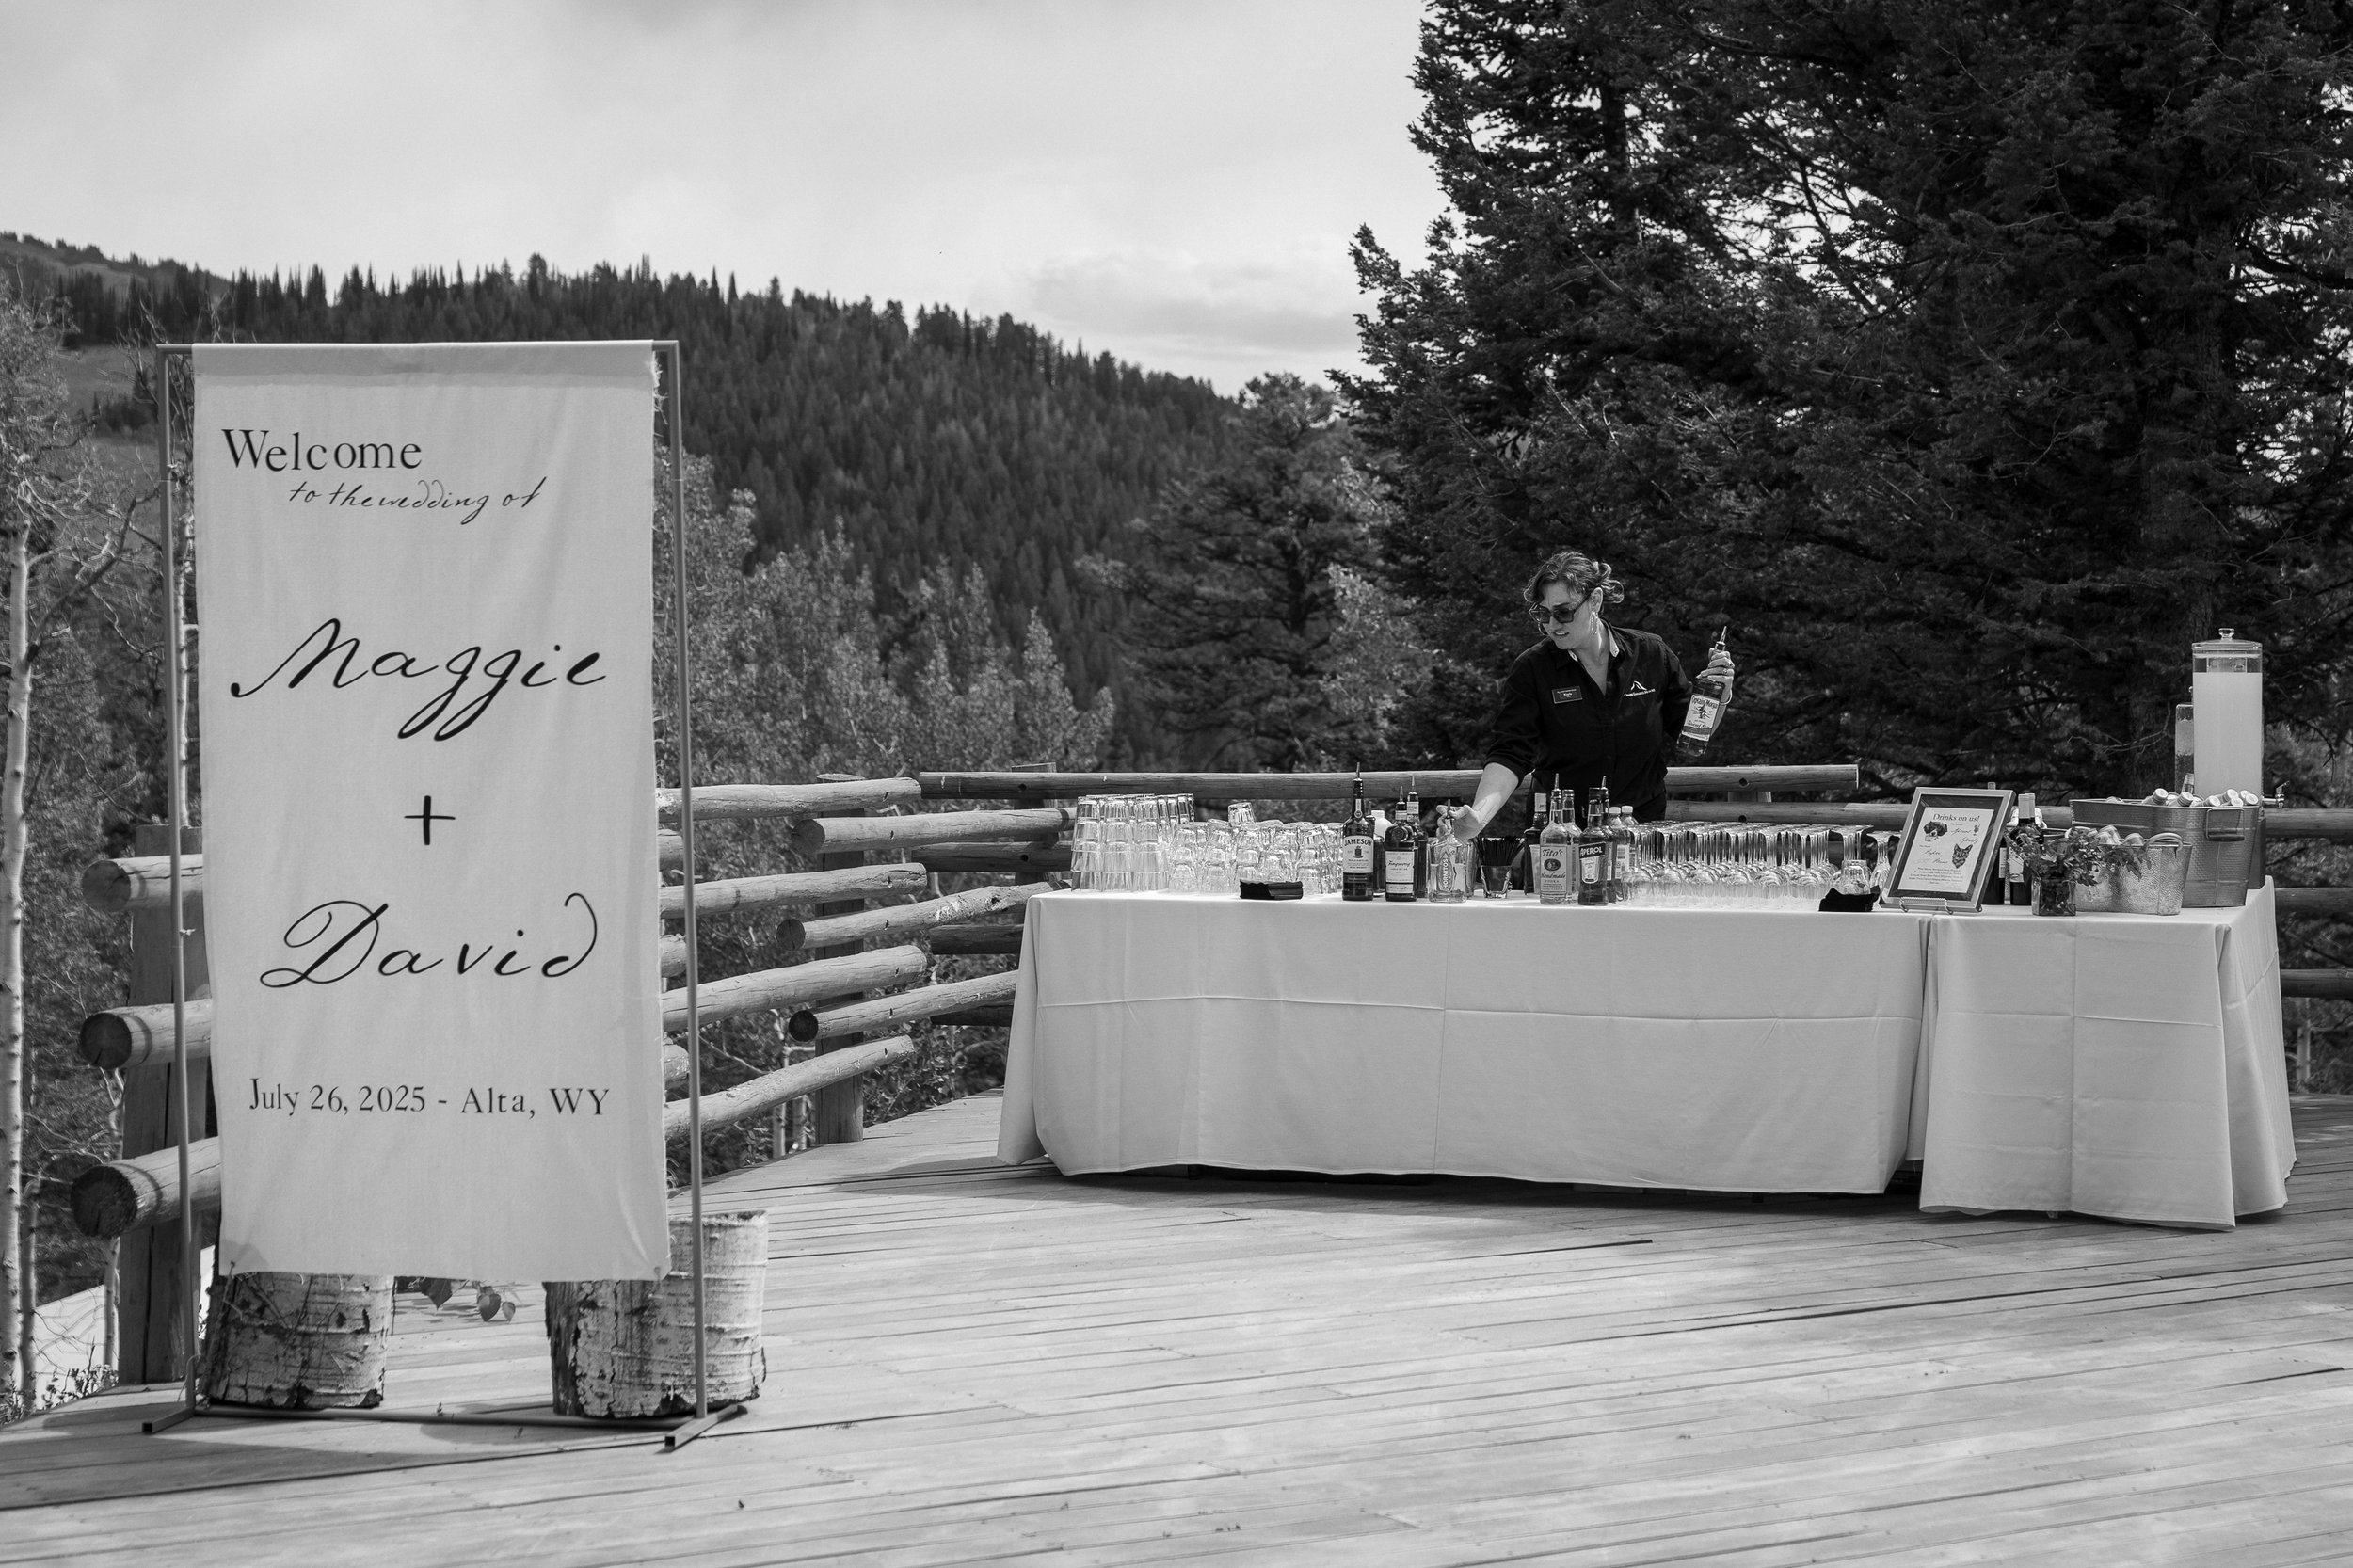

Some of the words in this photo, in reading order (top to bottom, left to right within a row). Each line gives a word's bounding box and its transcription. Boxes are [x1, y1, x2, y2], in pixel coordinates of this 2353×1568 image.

[220, 428, 423, 472] Welcome
[288, 480, 323, 504] to
[328, 482, 374, 507] the
[377, 478, 490, 526] wedding
[502, 475, 548, 509] of
[230, 617, 607, 742] Maggie
[404, 794, 456, 846] +
[1344, 838, 1373, 847] JAMESON
[1542, 848, 1564, 857] Tito's
[1580, 846, 1603, 856] APEROL
[260, 892, 598, 989] David
[248, 1077, 300, 1117] July
[309, 1084, 349, 1116] 26,
[358, 1084, 426, 1112] 2025
[460, 1087, 536, 1120] Alta,
[548, 1087, 610, 1116] WY
